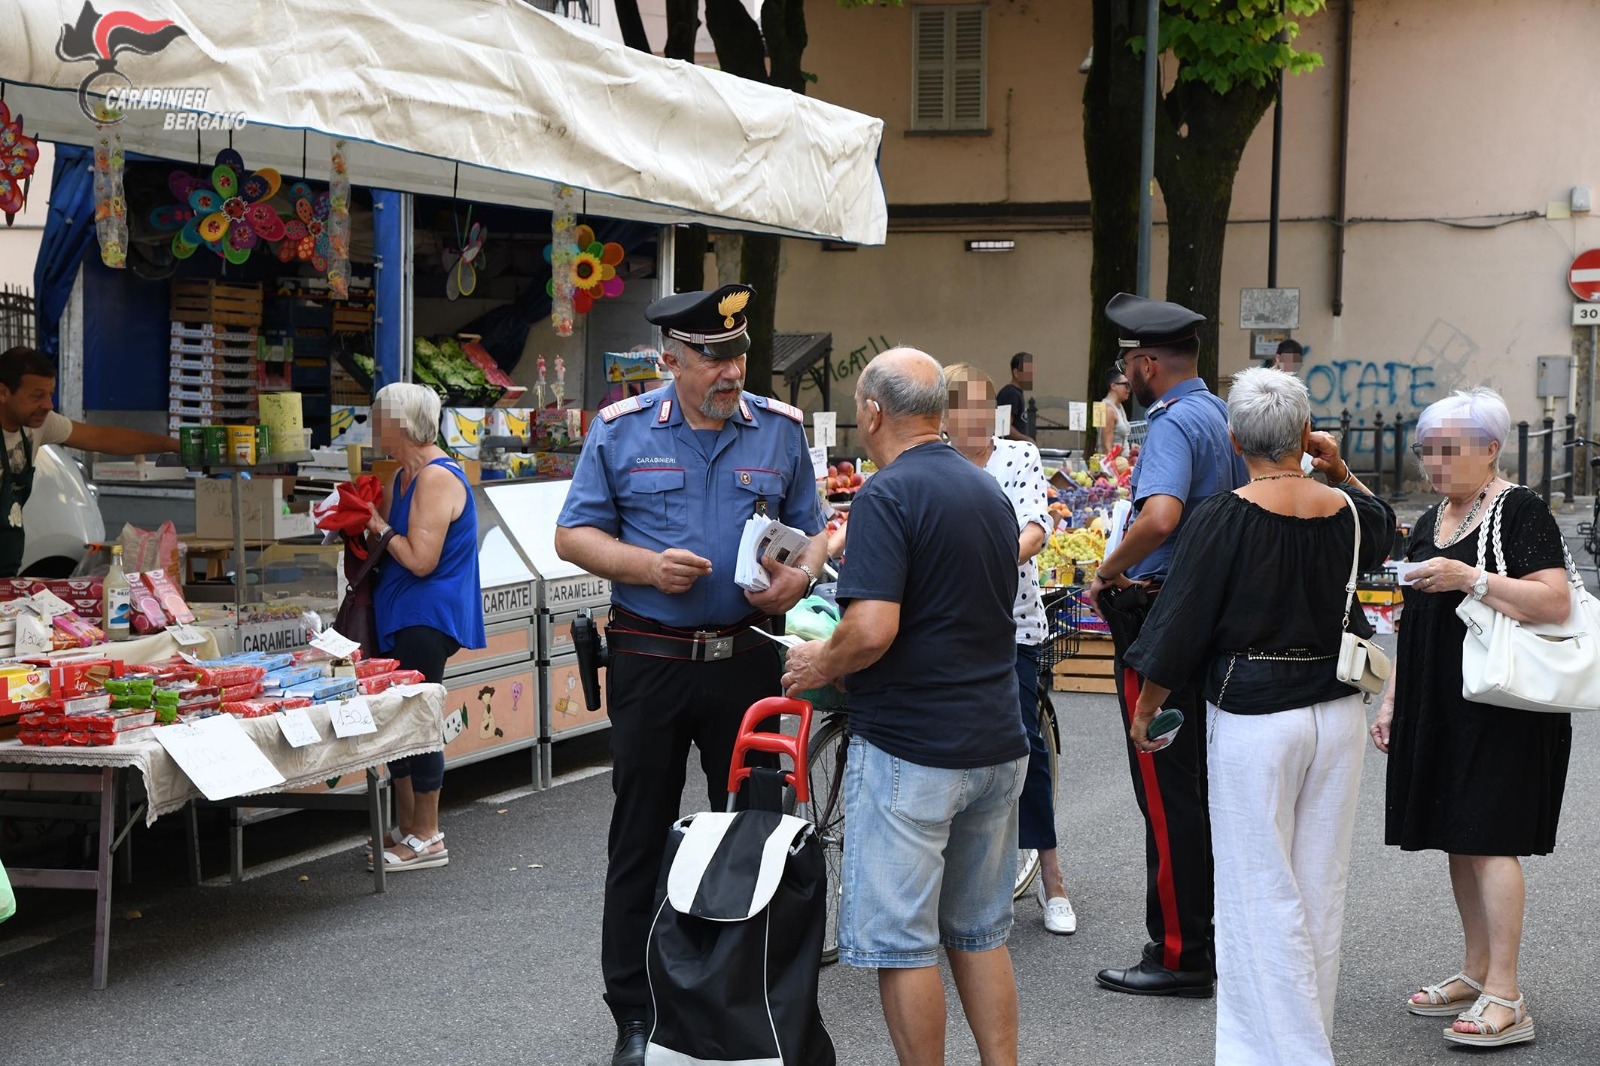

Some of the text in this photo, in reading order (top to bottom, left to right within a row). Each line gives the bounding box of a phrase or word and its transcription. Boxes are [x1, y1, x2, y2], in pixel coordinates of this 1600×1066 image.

[1580, 308, 1599, 319] 30
[1302, 345, 1436, 409] OTATE
[549, 580, 604, 602] ARAMELLE
[243, 627, 312, 653] CARAMELLE
